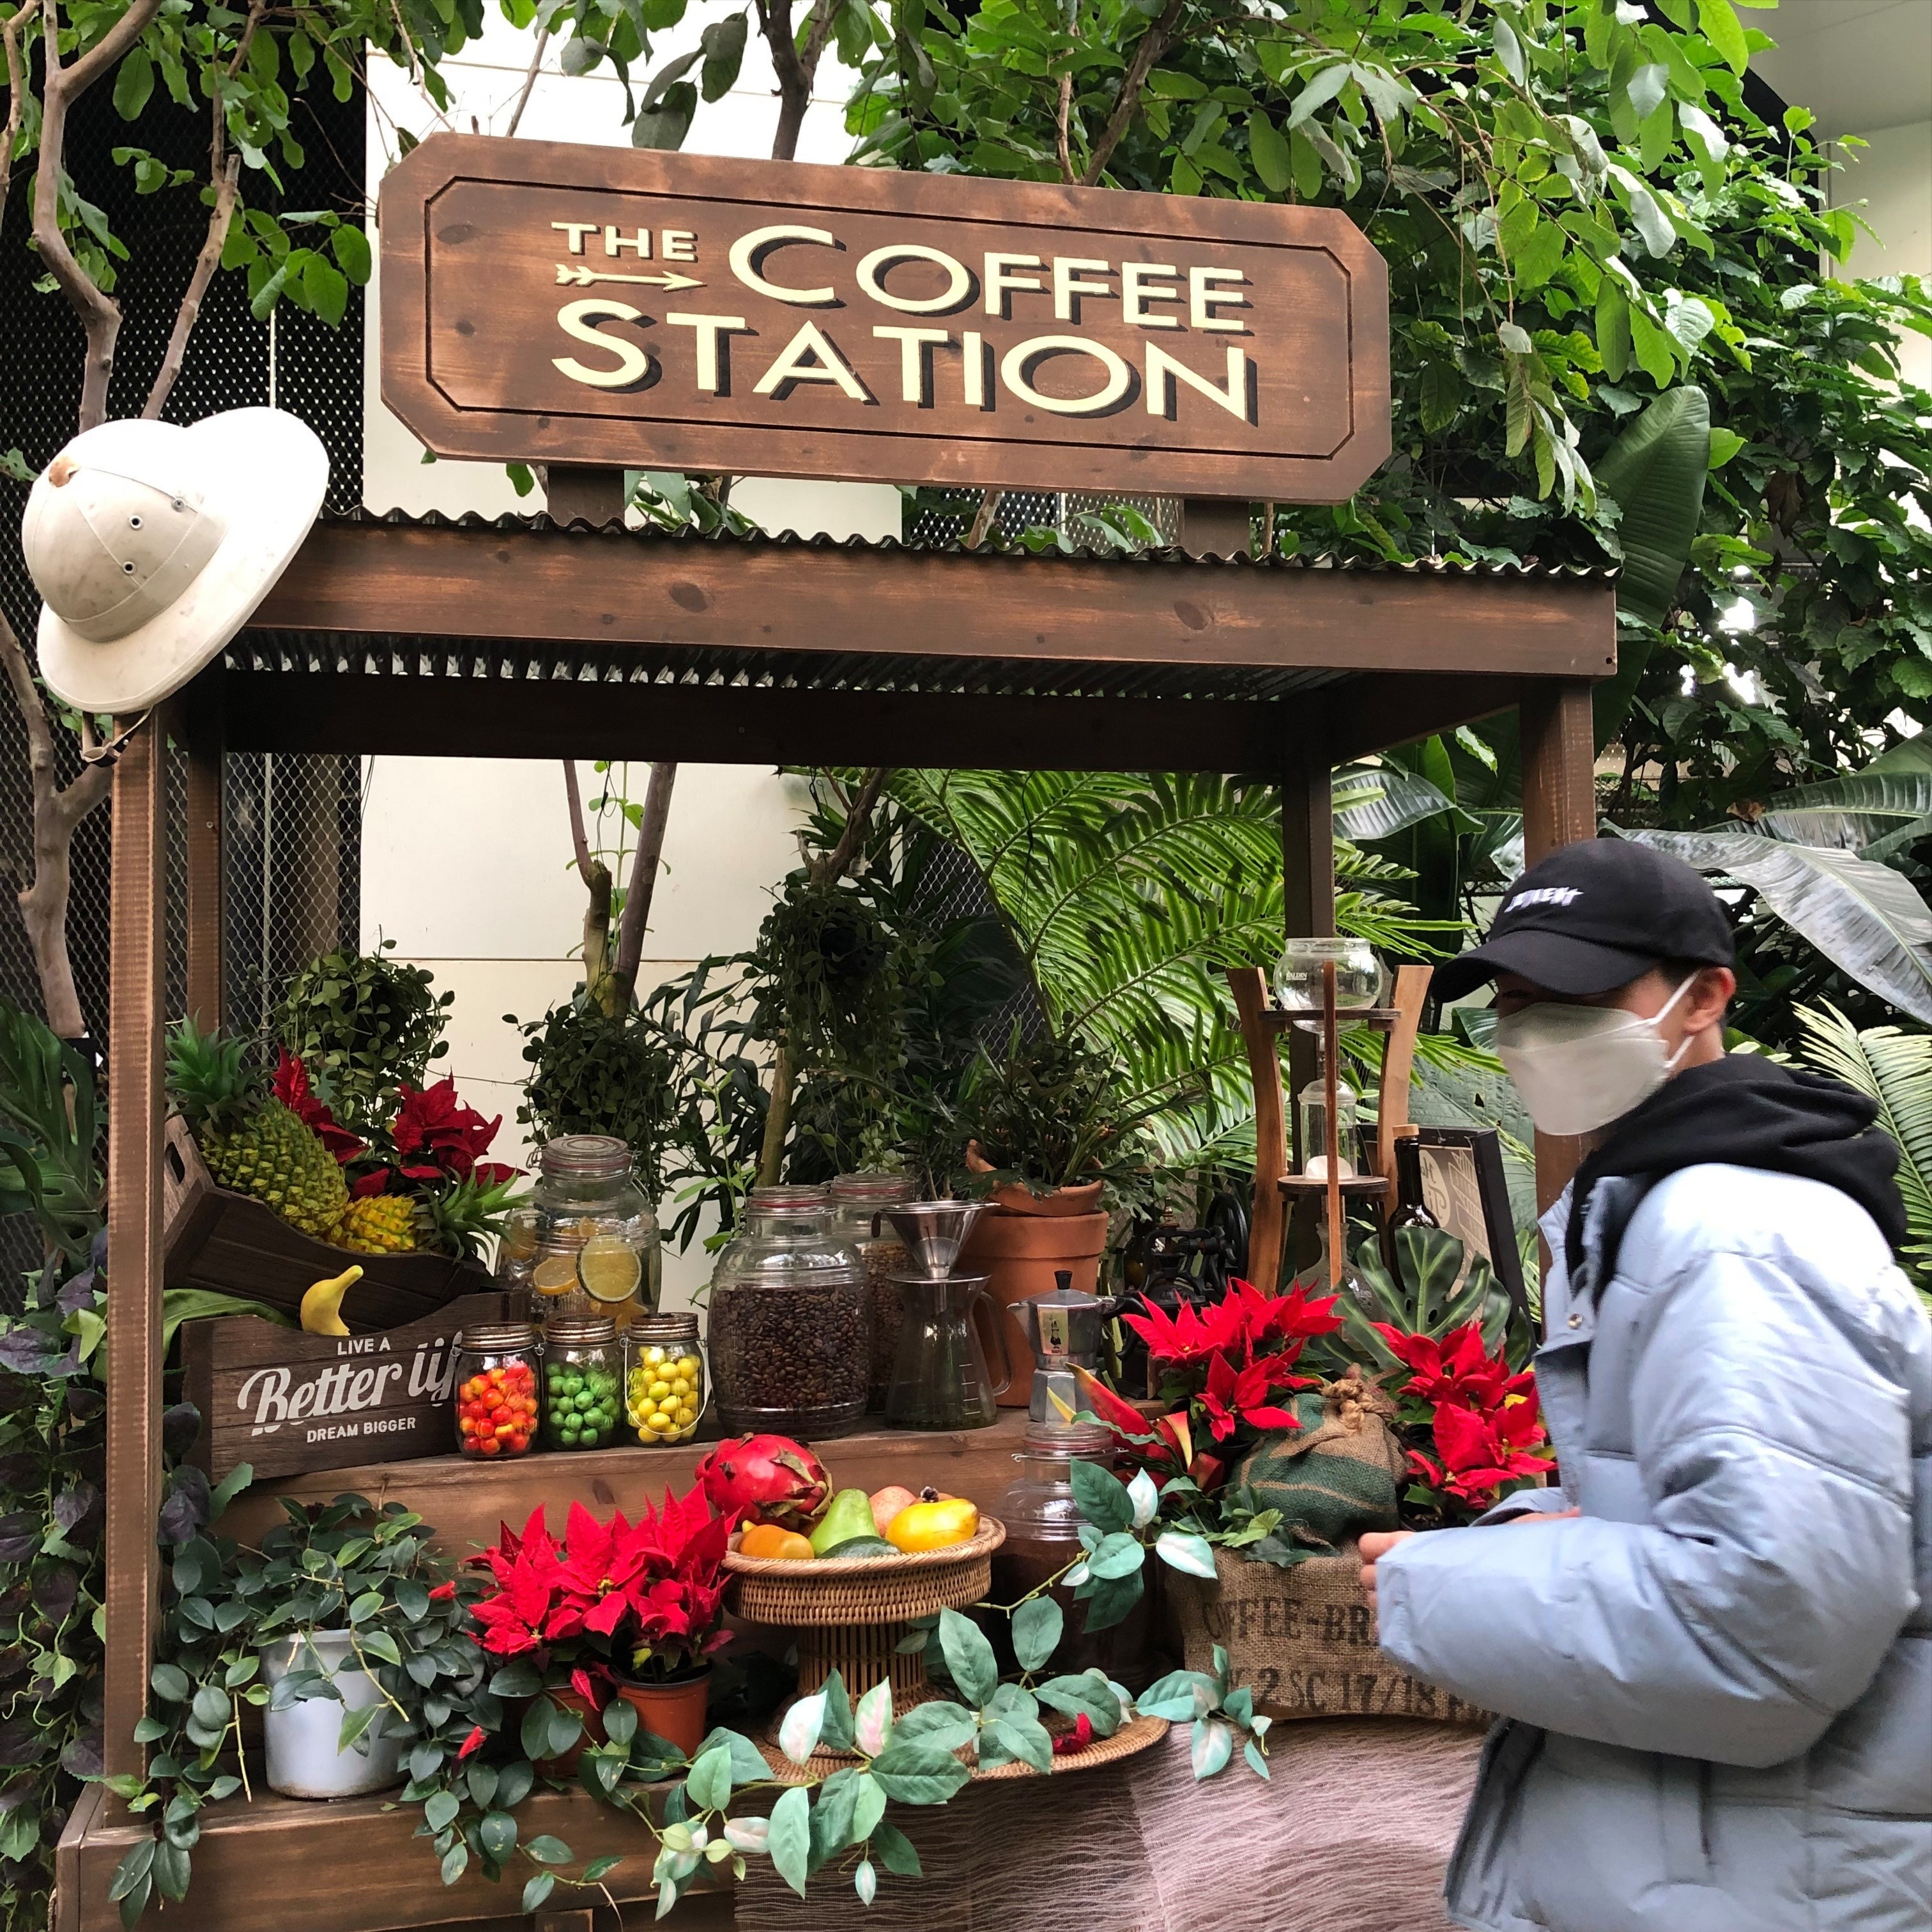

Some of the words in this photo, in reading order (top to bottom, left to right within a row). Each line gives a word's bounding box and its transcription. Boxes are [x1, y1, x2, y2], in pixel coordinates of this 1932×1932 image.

[551, 221, 698, 262] THE
[728, 224, 1254, 334] COFFEE
[551, 298, 1259, 427] STATION
[237, 1362, 402, 1436] Better
[408, 1330, 463, 1407] lif
[337, 1338, 374, 1356] LIVE
[378, 1337, 391, 1351] A
[307, 1425, 358, 1443] DREAM
[363, 1416, 417, 1436] BIGGER
